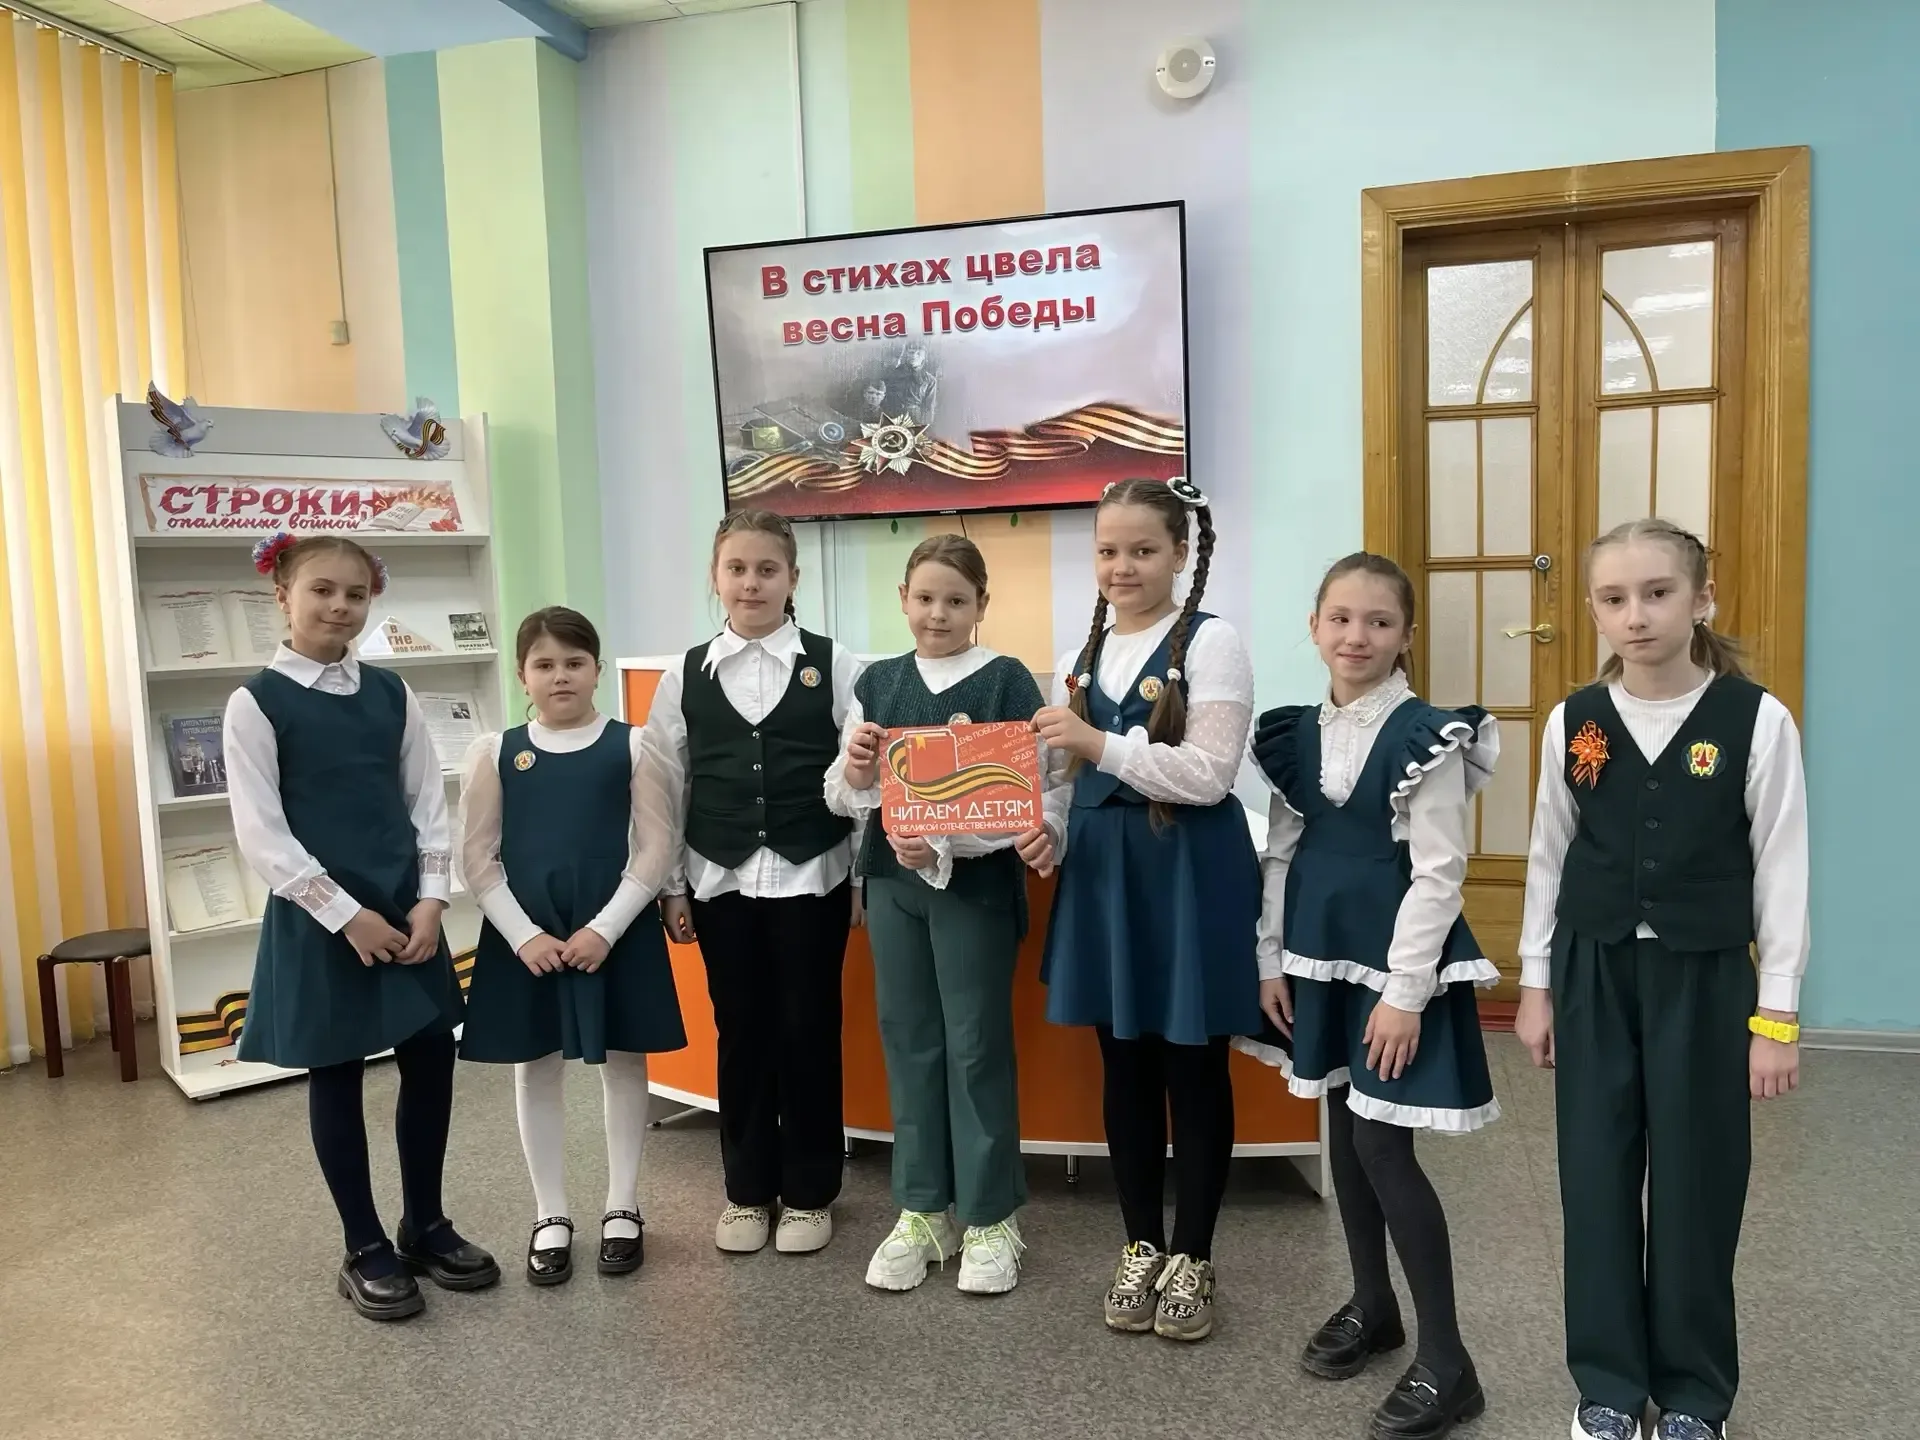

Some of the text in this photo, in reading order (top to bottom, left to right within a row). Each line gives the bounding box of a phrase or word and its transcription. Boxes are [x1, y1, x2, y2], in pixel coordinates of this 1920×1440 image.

[761, 242, 1102, 298] В стихах цвела
[783, 295, 1097, 346] весна Победы
[159, 484, 361, 516] СТРОКИ
[289, 511, 360, 530] войной
[890, 800, 1034, 821] ЧИТАЕМ ДЕТЯМ
[891, 817, 1035, 833] О ВЕЛИКОЙ ОТЕЧЕСТВЕННОЙ ВОЙНЕ
